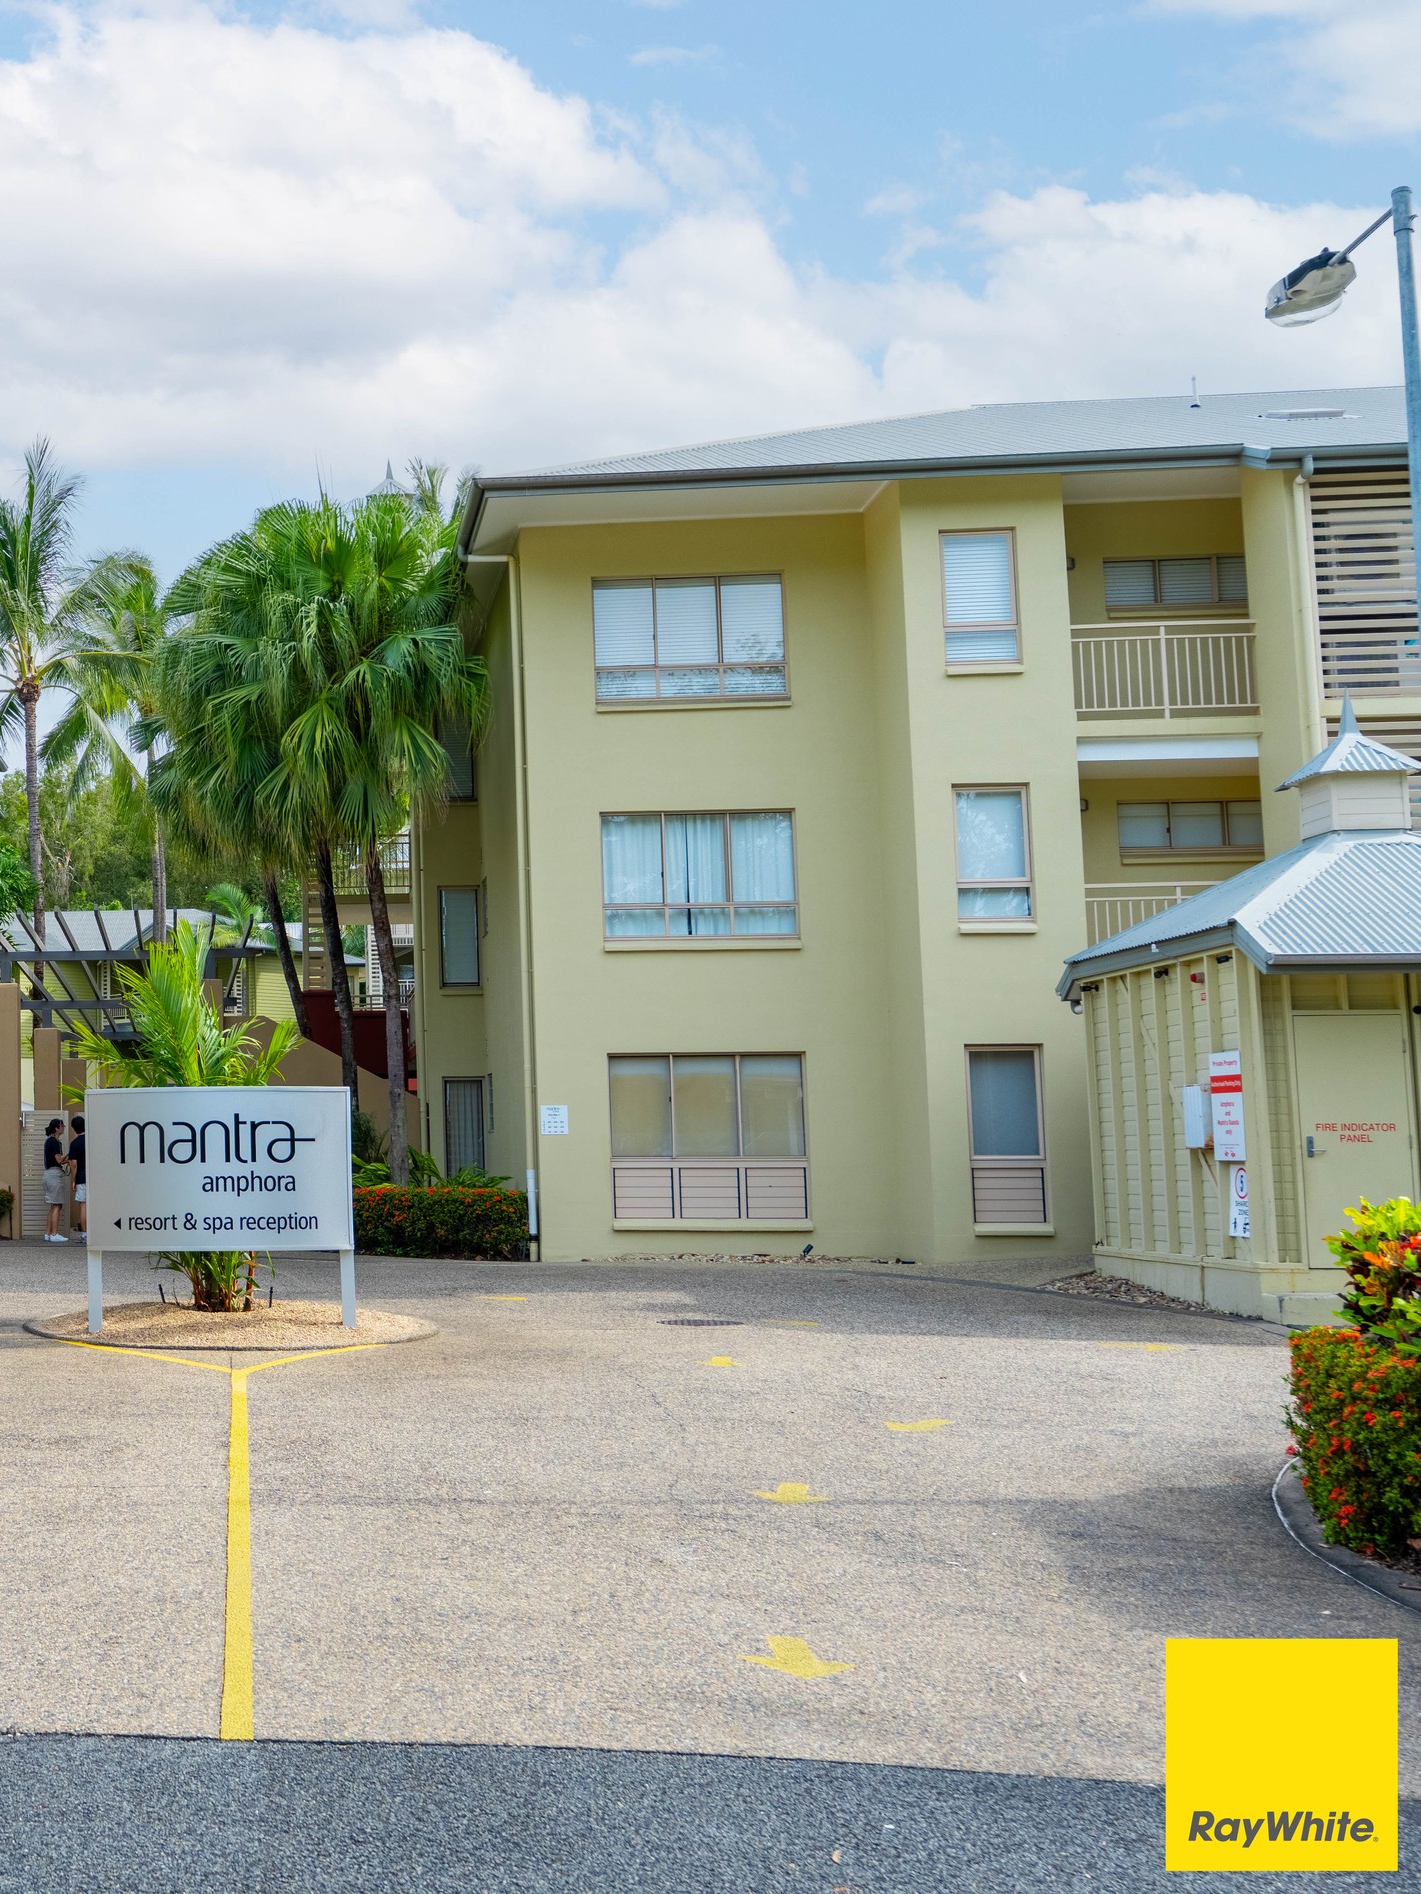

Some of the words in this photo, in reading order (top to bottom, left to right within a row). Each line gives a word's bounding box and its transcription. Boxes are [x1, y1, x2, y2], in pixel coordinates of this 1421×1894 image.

[120, 1112, 316, 1164] mantra
[1315, 1123, 1338, 1132] FIRE
[1340, 1123, 1397, 1132] INDICATOR
[1340, 1134, 1373, 1143] PANEL
[201, 1170, 296, 1197] amphora
[128, 1213, 178, 1231] resort
[183, 1212, 198, 1231] &
[203, 1215, 234, 1234] spa
[239, 1211, 319, 1234] reception
